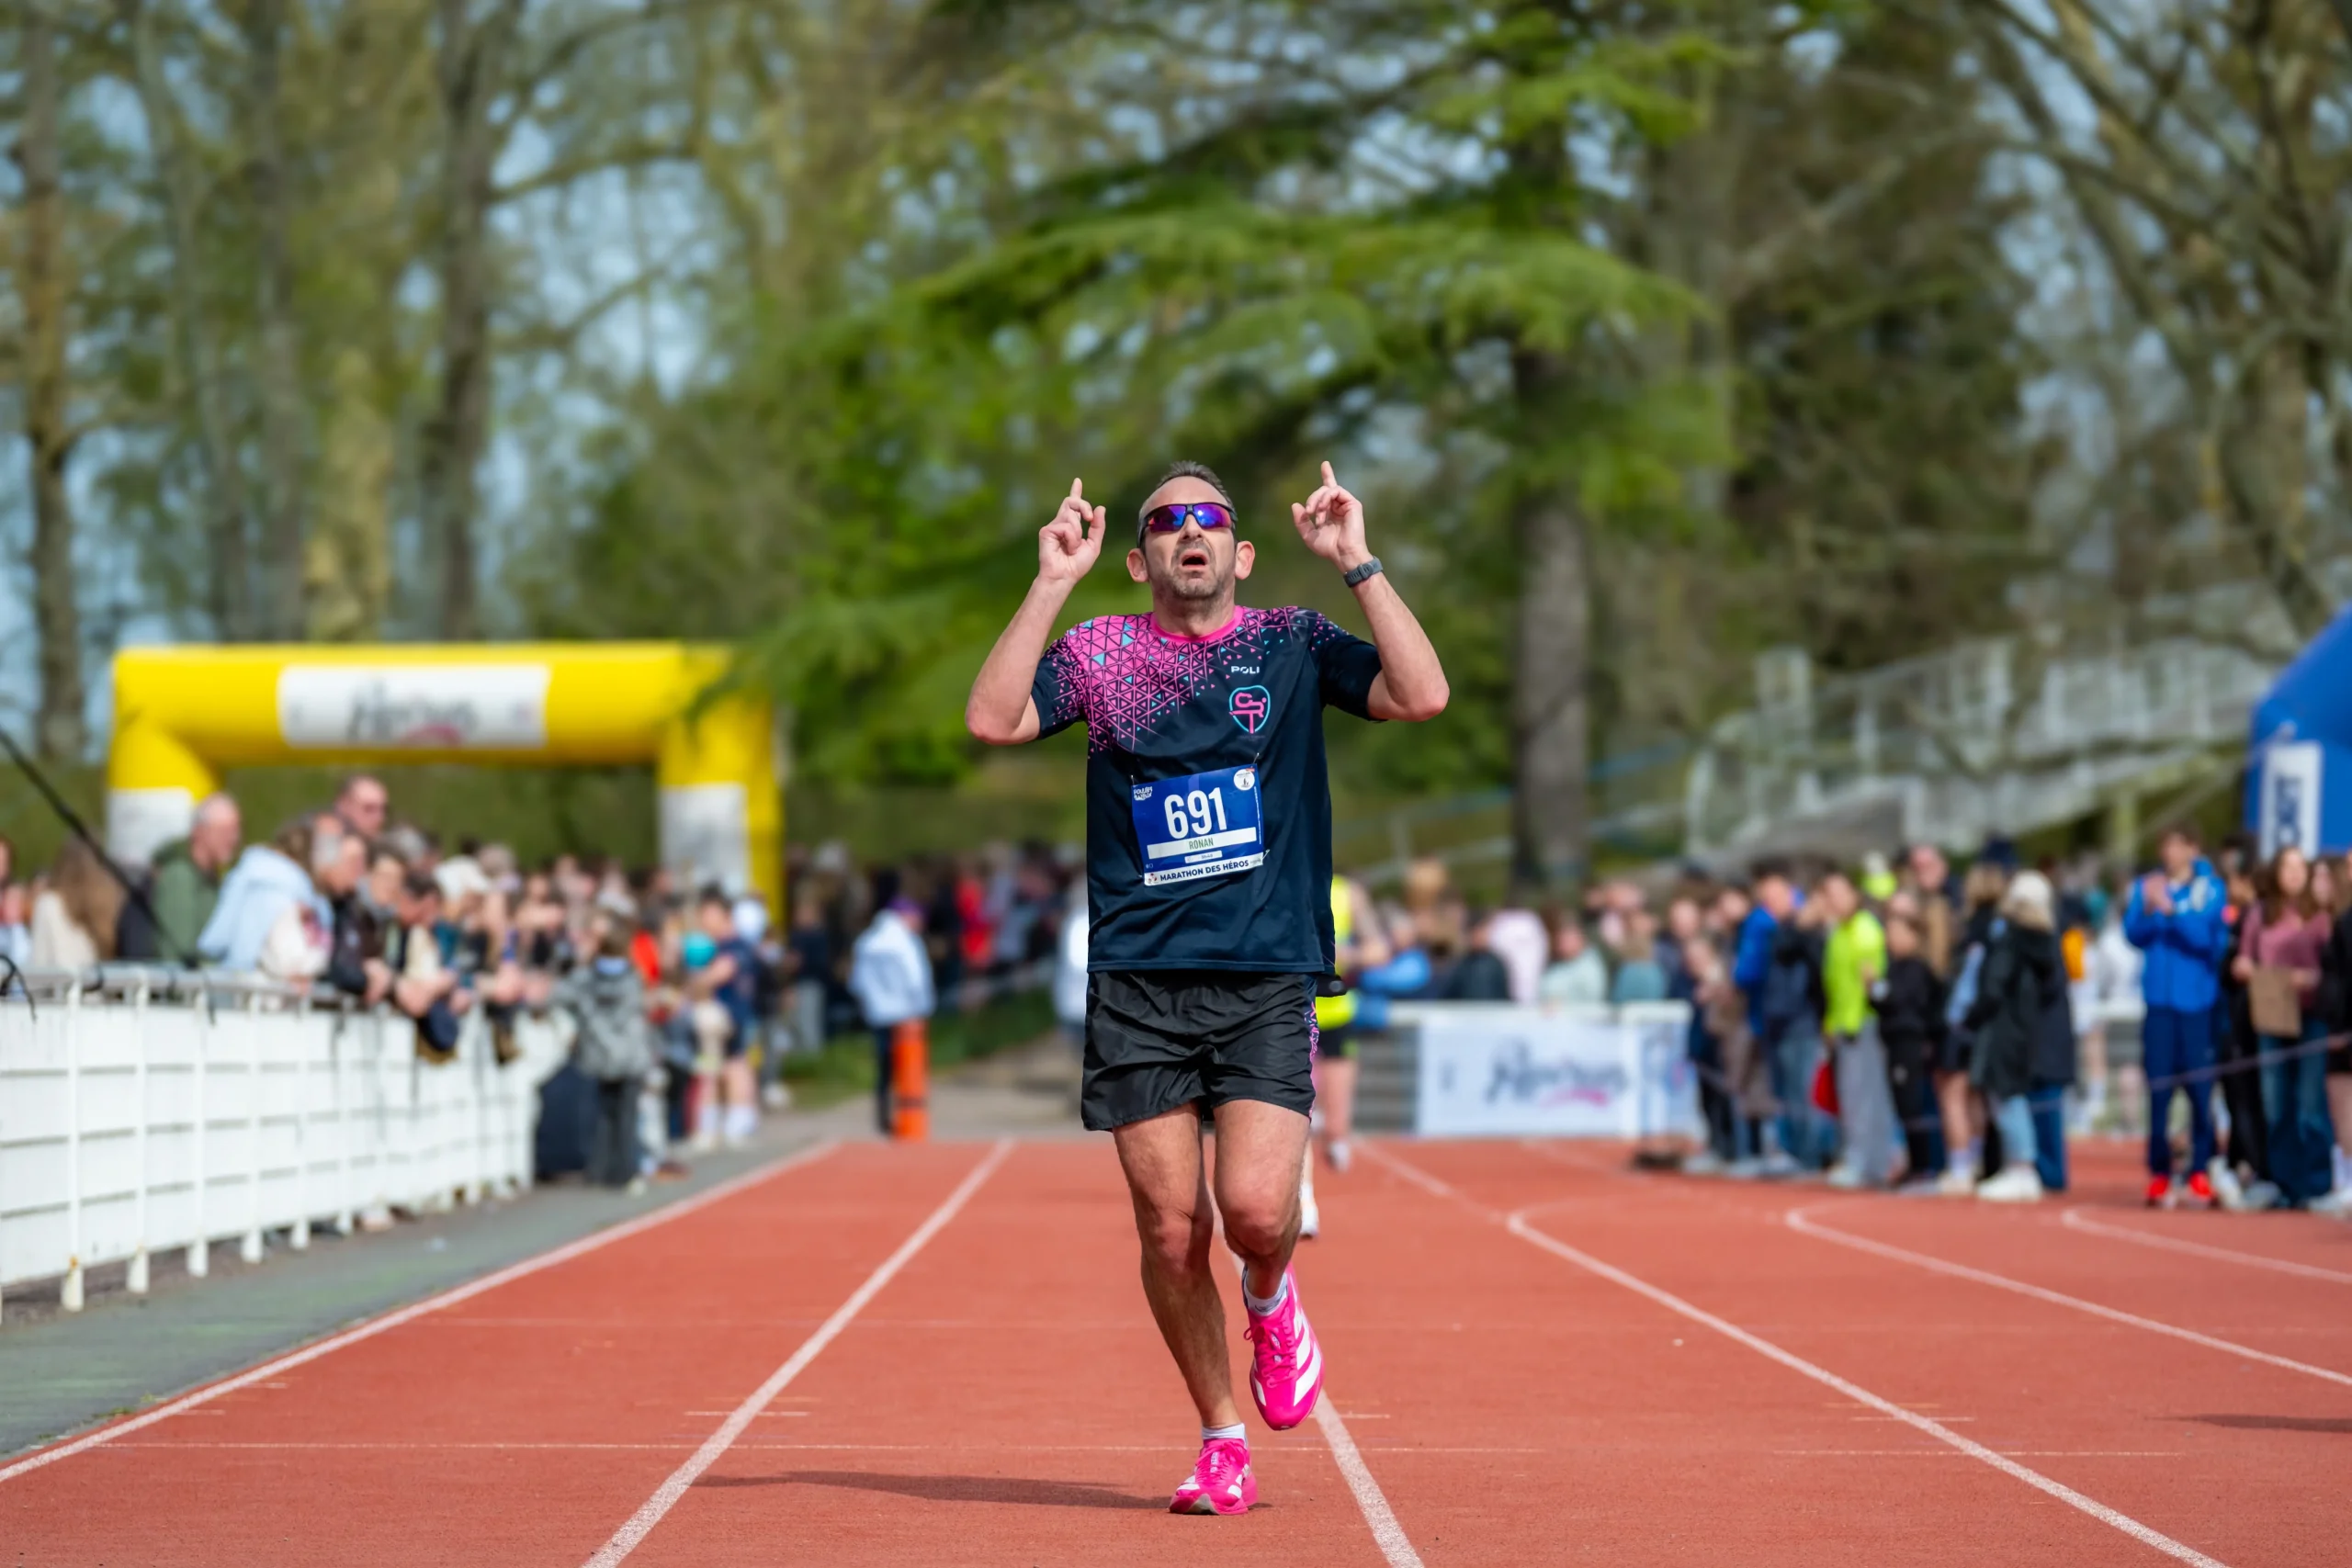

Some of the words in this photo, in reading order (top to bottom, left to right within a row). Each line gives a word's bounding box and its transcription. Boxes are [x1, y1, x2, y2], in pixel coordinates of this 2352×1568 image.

[1231, 666, 1260, 674] POLI
[1164, 787, 1227, 840] 691
[1189, 838, 1214, 850] RONAN
[1159, 869, 1204, 881] MARATHON
[1205, 865, 1221, 874] DES
[1223, 861, 1249, 872] HÉROS
